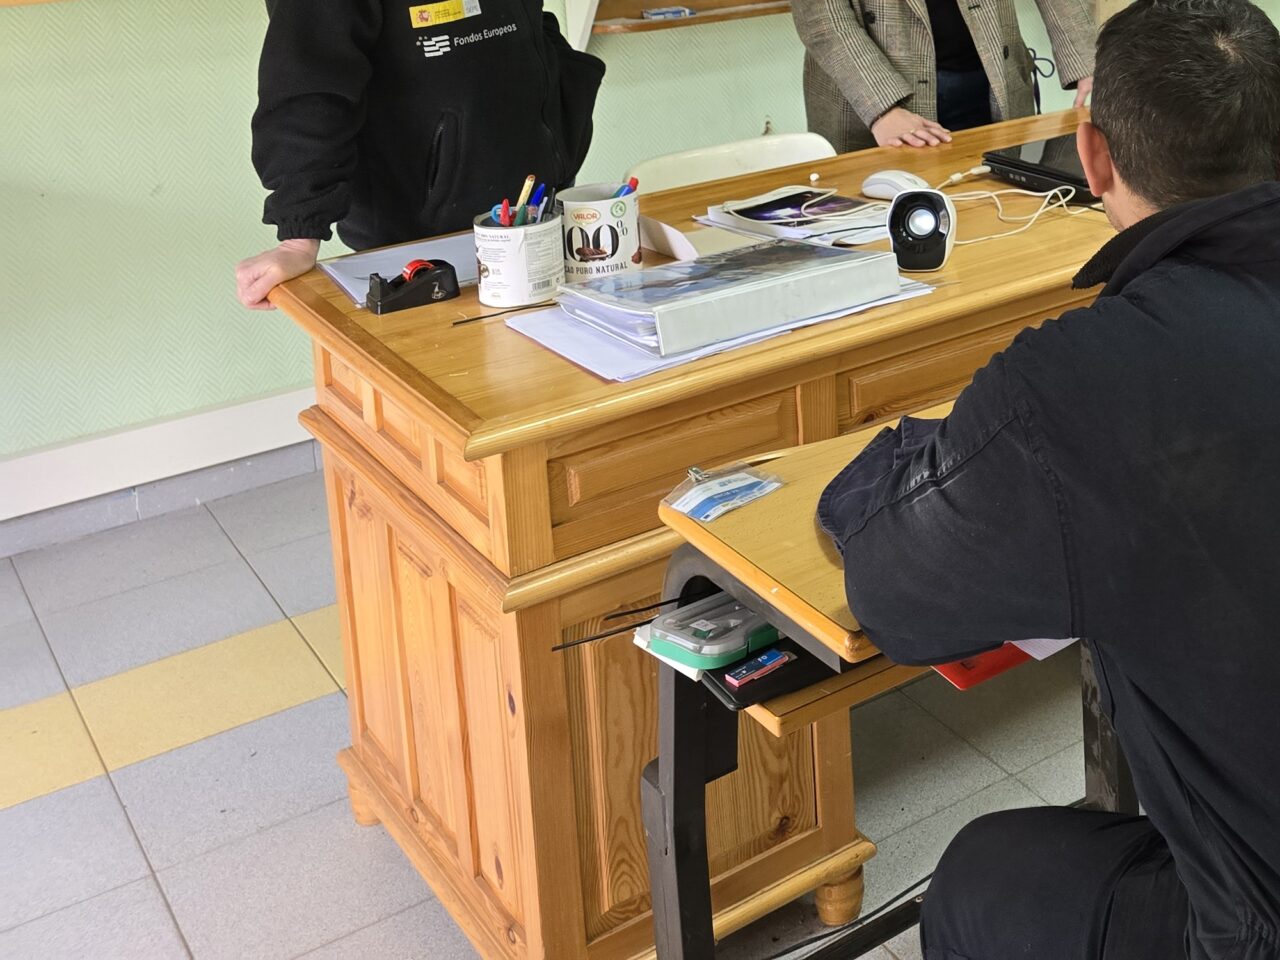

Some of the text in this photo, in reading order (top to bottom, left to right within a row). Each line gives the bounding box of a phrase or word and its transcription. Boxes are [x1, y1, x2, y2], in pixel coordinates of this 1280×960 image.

[453, 23, 518, 47] Fondos Europeos
[575, 267, 593, 275] PURO
[595, 261, 629, 274] NATURAL
